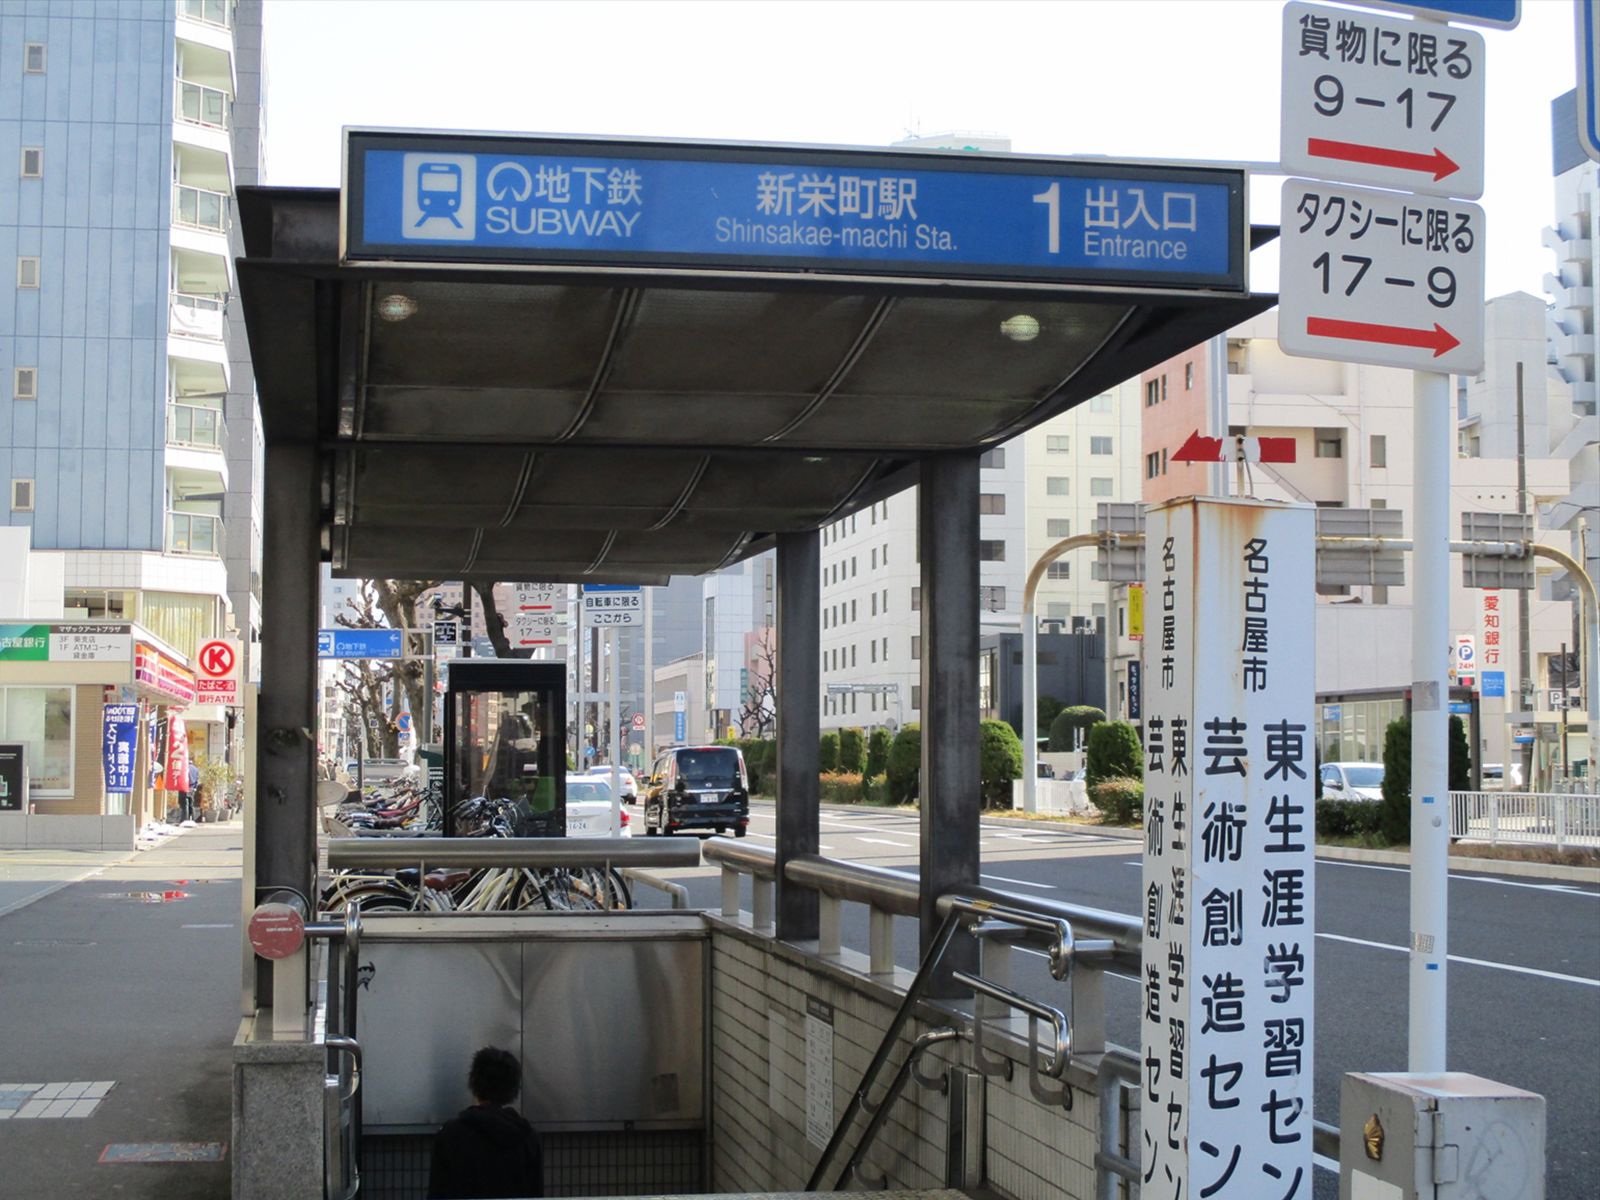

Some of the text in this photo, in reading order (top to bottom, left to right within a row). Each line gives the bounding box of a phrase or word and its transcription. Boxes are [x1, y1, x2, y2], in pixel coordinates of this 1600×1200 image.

[1299, 14, 1472, 80] 貨物に限る
[535, 165, 643, 206] 地下鉄
[756, 171, 918, 221] 新栄町駅
[1084, 186, 1197, 232] 出入口
[485, 207, 642, 238] SUBWAY
[715, 217, 958, 251] Shinsakae-machi Sta.
[1032, 182, 1061, 254] 1
[1084, 231, 1188, 260] Entrance
[1297, 193, 1474, 253] タクシーに限る
[586, 596, 639, 607] 自転車に限る
[594, 613, 632, 624] ここから
[1162, 537, 1175, 690] 名古屋市
[1242, 537, 1268, 692] 名古屋市
[0, 636, 46, 649] 古屋銀行
[1484, 595, 1500, 664] 愛知銀行
[1144, 715, 1164, 1183] 芸術創造セン
[1200, 717, 1248, 1198] 芸術創造セン
[1261, 718, 1307, 1200] 東生涯学習セン
